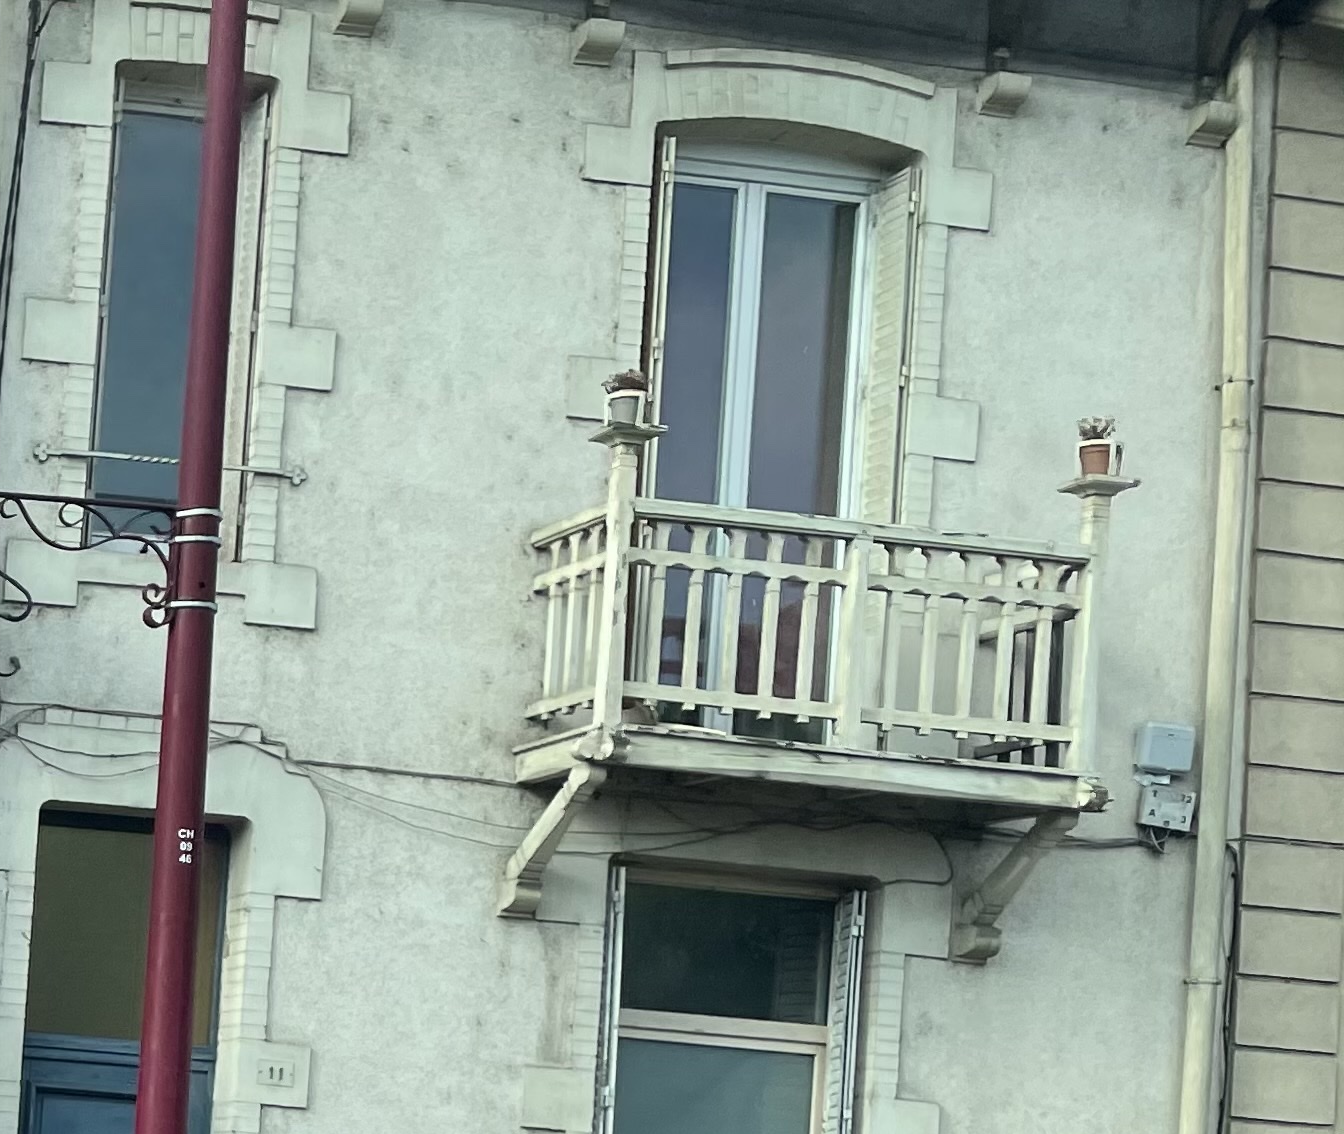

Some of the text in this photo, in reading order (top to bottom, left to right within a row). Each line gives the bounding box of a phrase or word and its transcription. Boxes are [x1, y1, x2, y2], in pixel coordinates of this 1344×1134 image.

[177, 828, 195, 839] CH
[179, 840, 193, 852] 09
[178, 853, 192, 864] 46
[269, 1066, 283, 1081] 11
